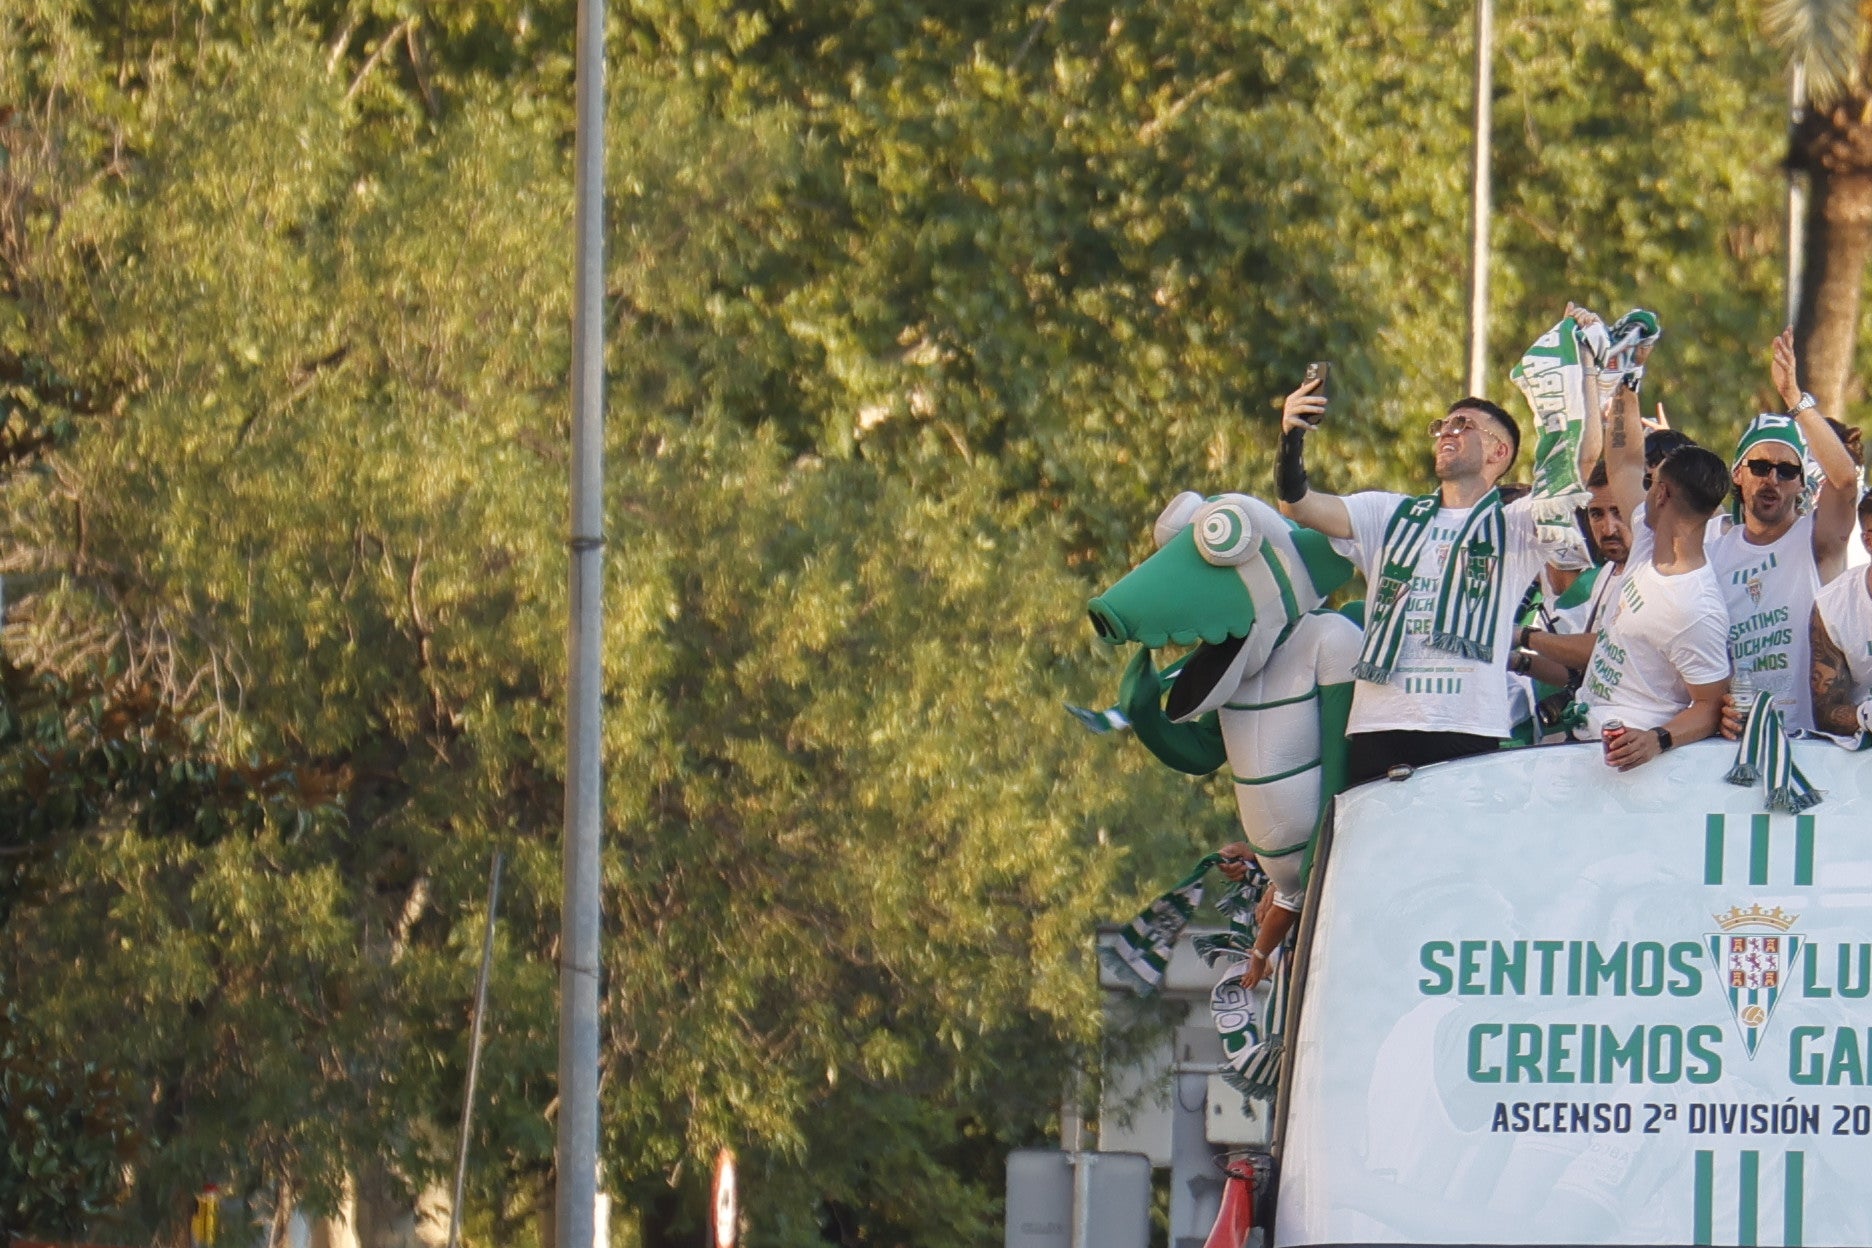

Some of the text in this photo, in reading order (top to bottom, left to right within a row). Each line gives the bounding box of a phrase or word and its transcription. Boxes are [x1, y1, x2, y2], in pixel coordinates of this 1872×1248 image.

[1419, 940, 1703, 998] SENTIMOS
[1467, 1023, 1724, 1086] CREIMOS
[1491, 1100, 1632, 1134] ASCENSO
[1642, 1103, 1678, 1134] 2ª
[1687, 1097, 1820, 1136] DIVISIÓN
